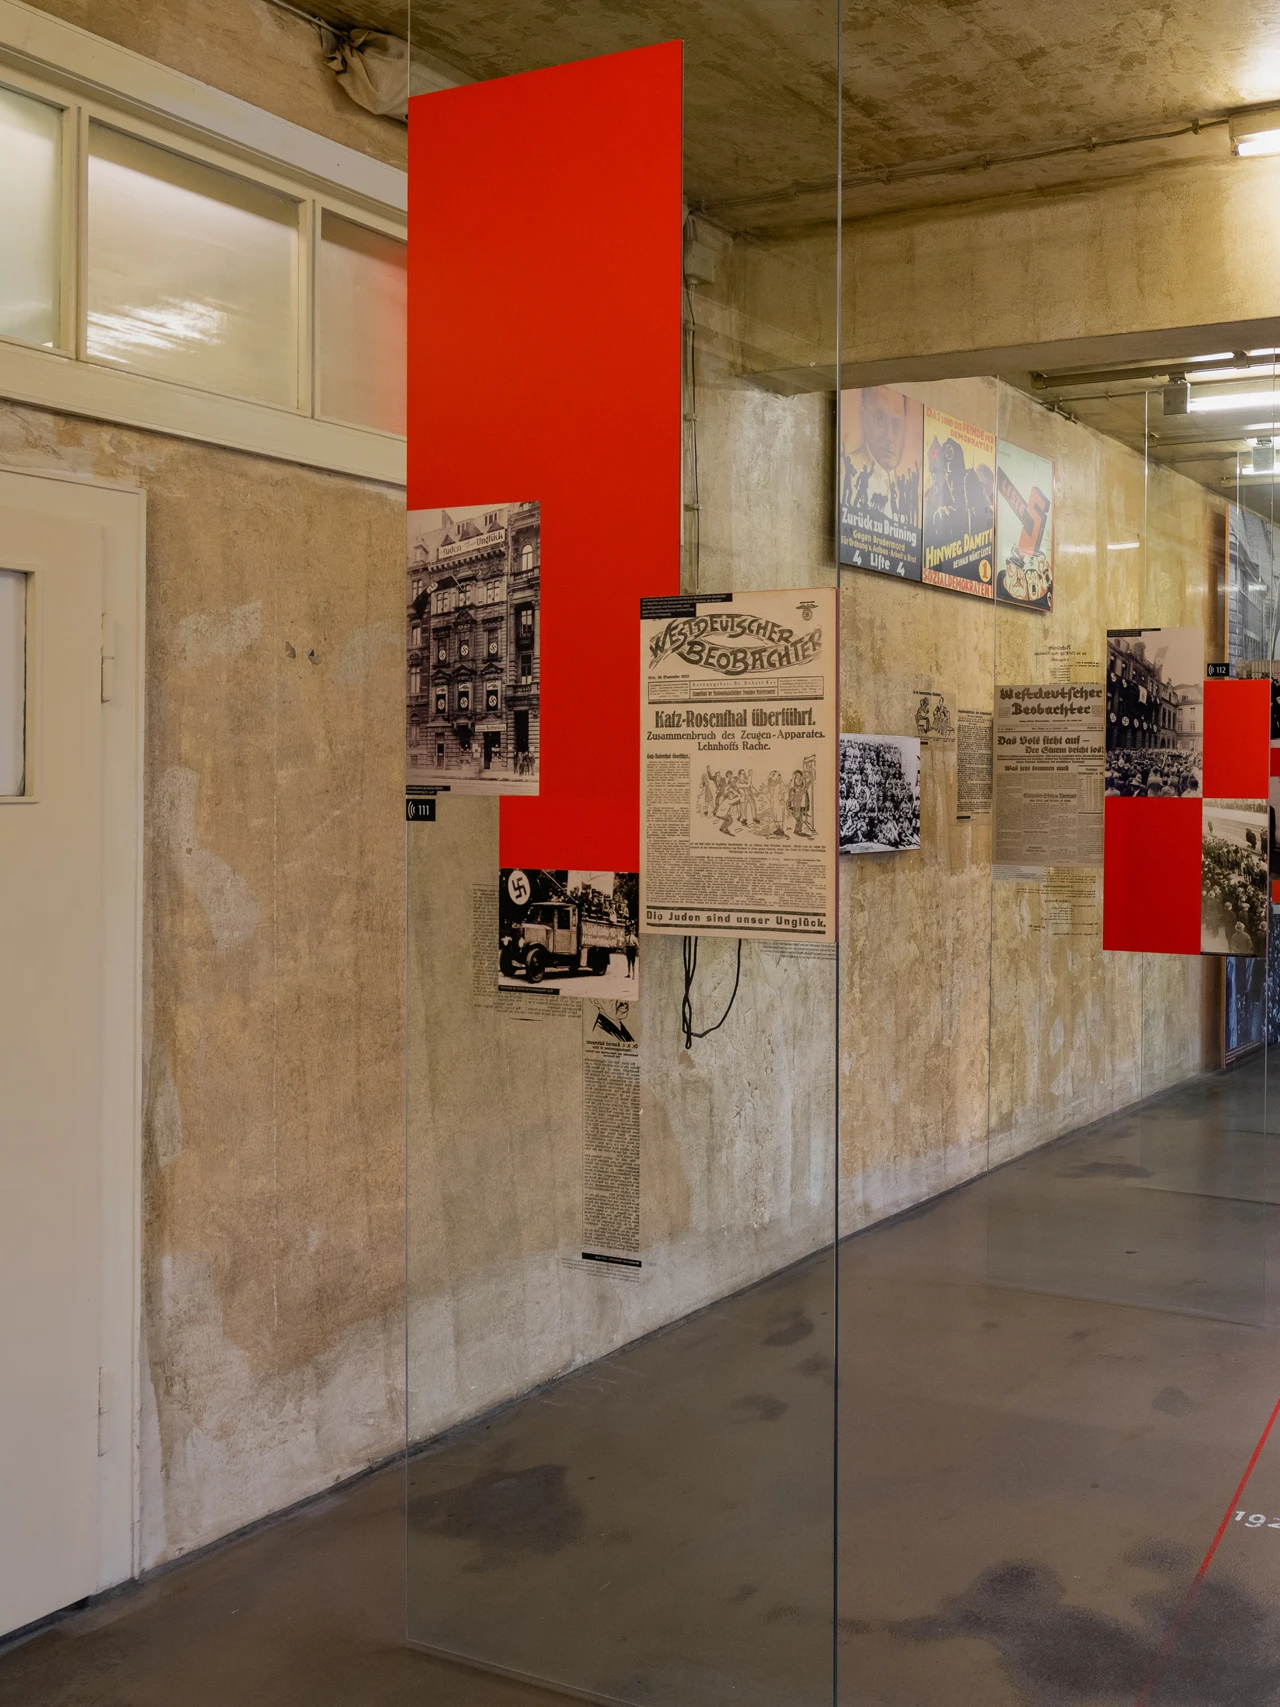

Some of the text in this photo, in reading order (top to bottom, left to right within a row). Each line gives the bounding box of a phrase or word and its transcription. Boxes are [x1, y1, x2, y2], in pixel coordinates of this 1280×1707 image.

[950, 429, 993, 453] DEMOKRATIE!
[963, 422, 985, 440] FEINDE
[985, 431, 994, 444] DER
[842, 507, 917, 547] Zurück zu Brüning
[853, 530, 872, 542] Gegen
[925, 528, 993, 569] HINWEG DAMIT!
[852, 550, 905, 576] 4 Liste 4
[982, 561, 989, 579] 1
[923, 568, 993, 598] SOZIALDEMOKRATEN!
[648, 613, 793, 659] WESTDEUTSCHER
[677, 628, 823, 676] BEOBACHTER
[1216, 666, 1226, 674] 112
[1000, 686, 1103, 703] Westdeutscher
[655, 707, 816, 728] Katz-Rosenthal überführt.
[1011, 702, 1091, 718] Beobachter
[647, 731, 716, 740] Zusammenbruch
[721, 731, 735, 740] des
[997, 736, 1017, 745] Das
[1043, 736, 1063, 745] steht
[1065, 735, 1080, 745] auf
[697, 741, 771, 751] Lehnhoffs Rache.
[1025, 746, 1039, 754] Der
[1041, 746, 1066, 754] Sturm
[418, 805, 429, 816] 111
[646, 911, 826, 929] Die Juden sind unser Unglück.
